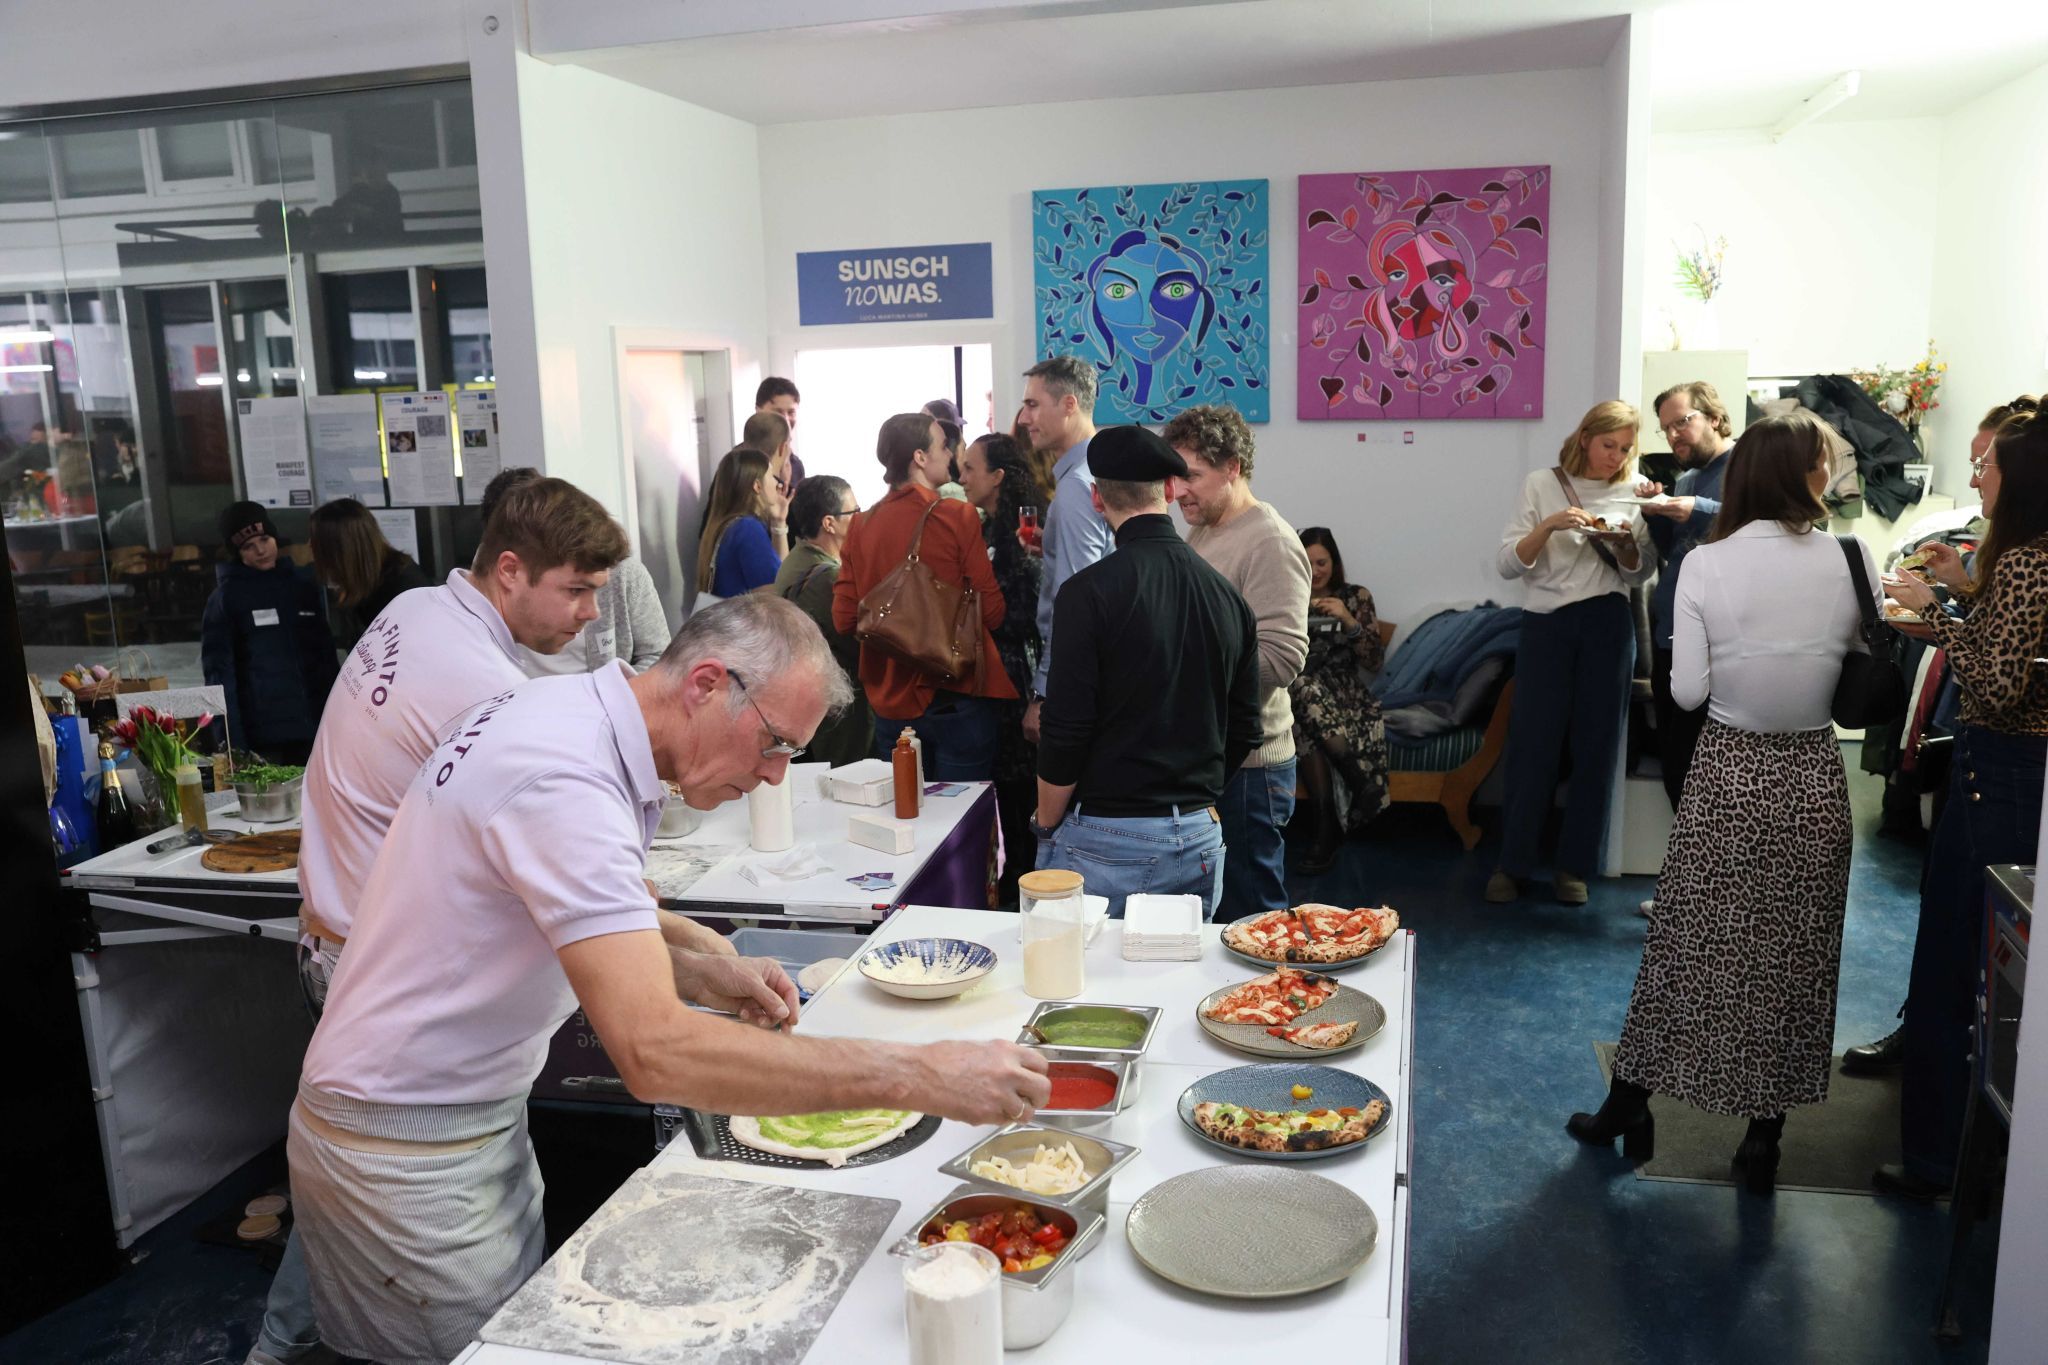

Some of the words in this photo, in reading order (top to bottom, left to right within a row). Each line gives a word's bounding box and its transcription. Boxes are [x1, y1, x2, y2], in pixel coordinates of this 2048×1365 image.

[838, 255, 949, 282] SUNSCH
[845, 282, 942, 306] noWAS.
[371, 623, 400, 707] FINITO
